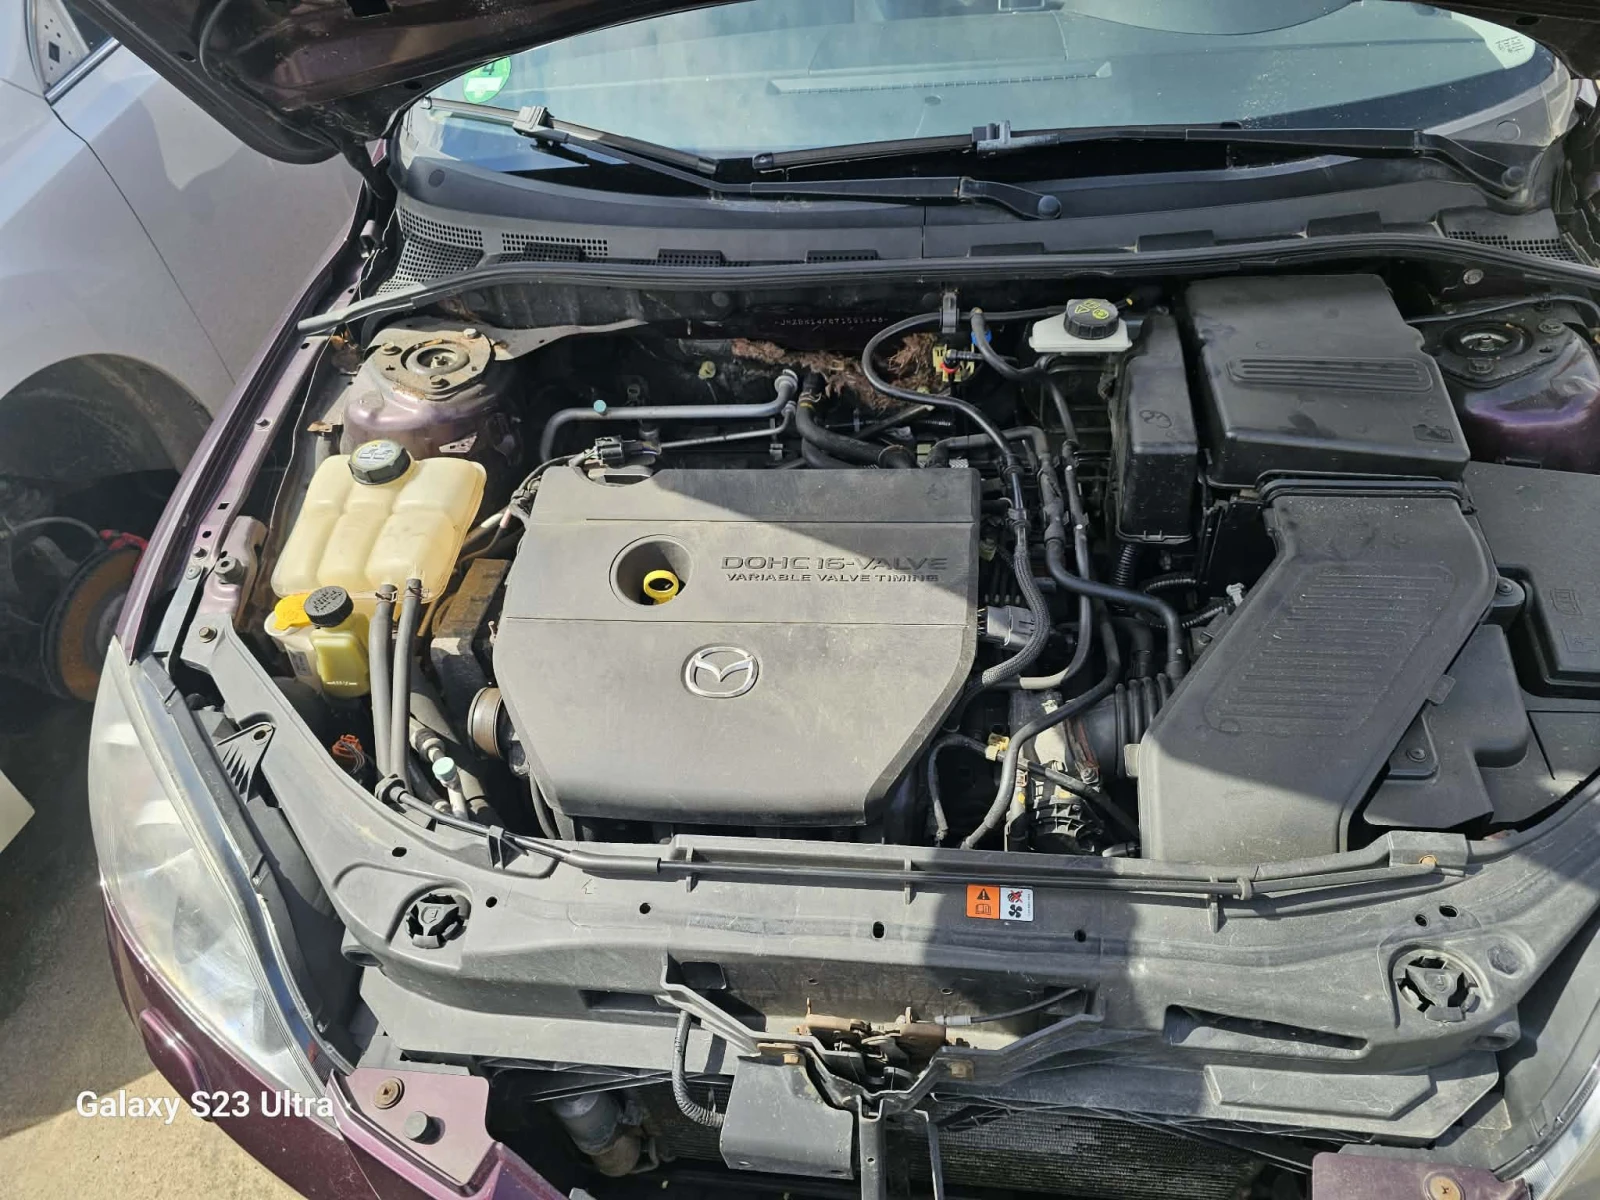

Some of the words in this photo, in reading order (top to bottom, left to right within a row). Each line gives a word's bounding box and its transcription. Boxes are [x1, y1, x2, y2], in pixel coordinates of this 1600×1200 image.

[721, 556, 810, 570] DOHC
[816, 556, 948, 571] 16-VALVE
[726, 573, 812, 582] VARIABLE
[817, 574, 871, 582] VALVE
[874, 574, 939, 582] TIMING
